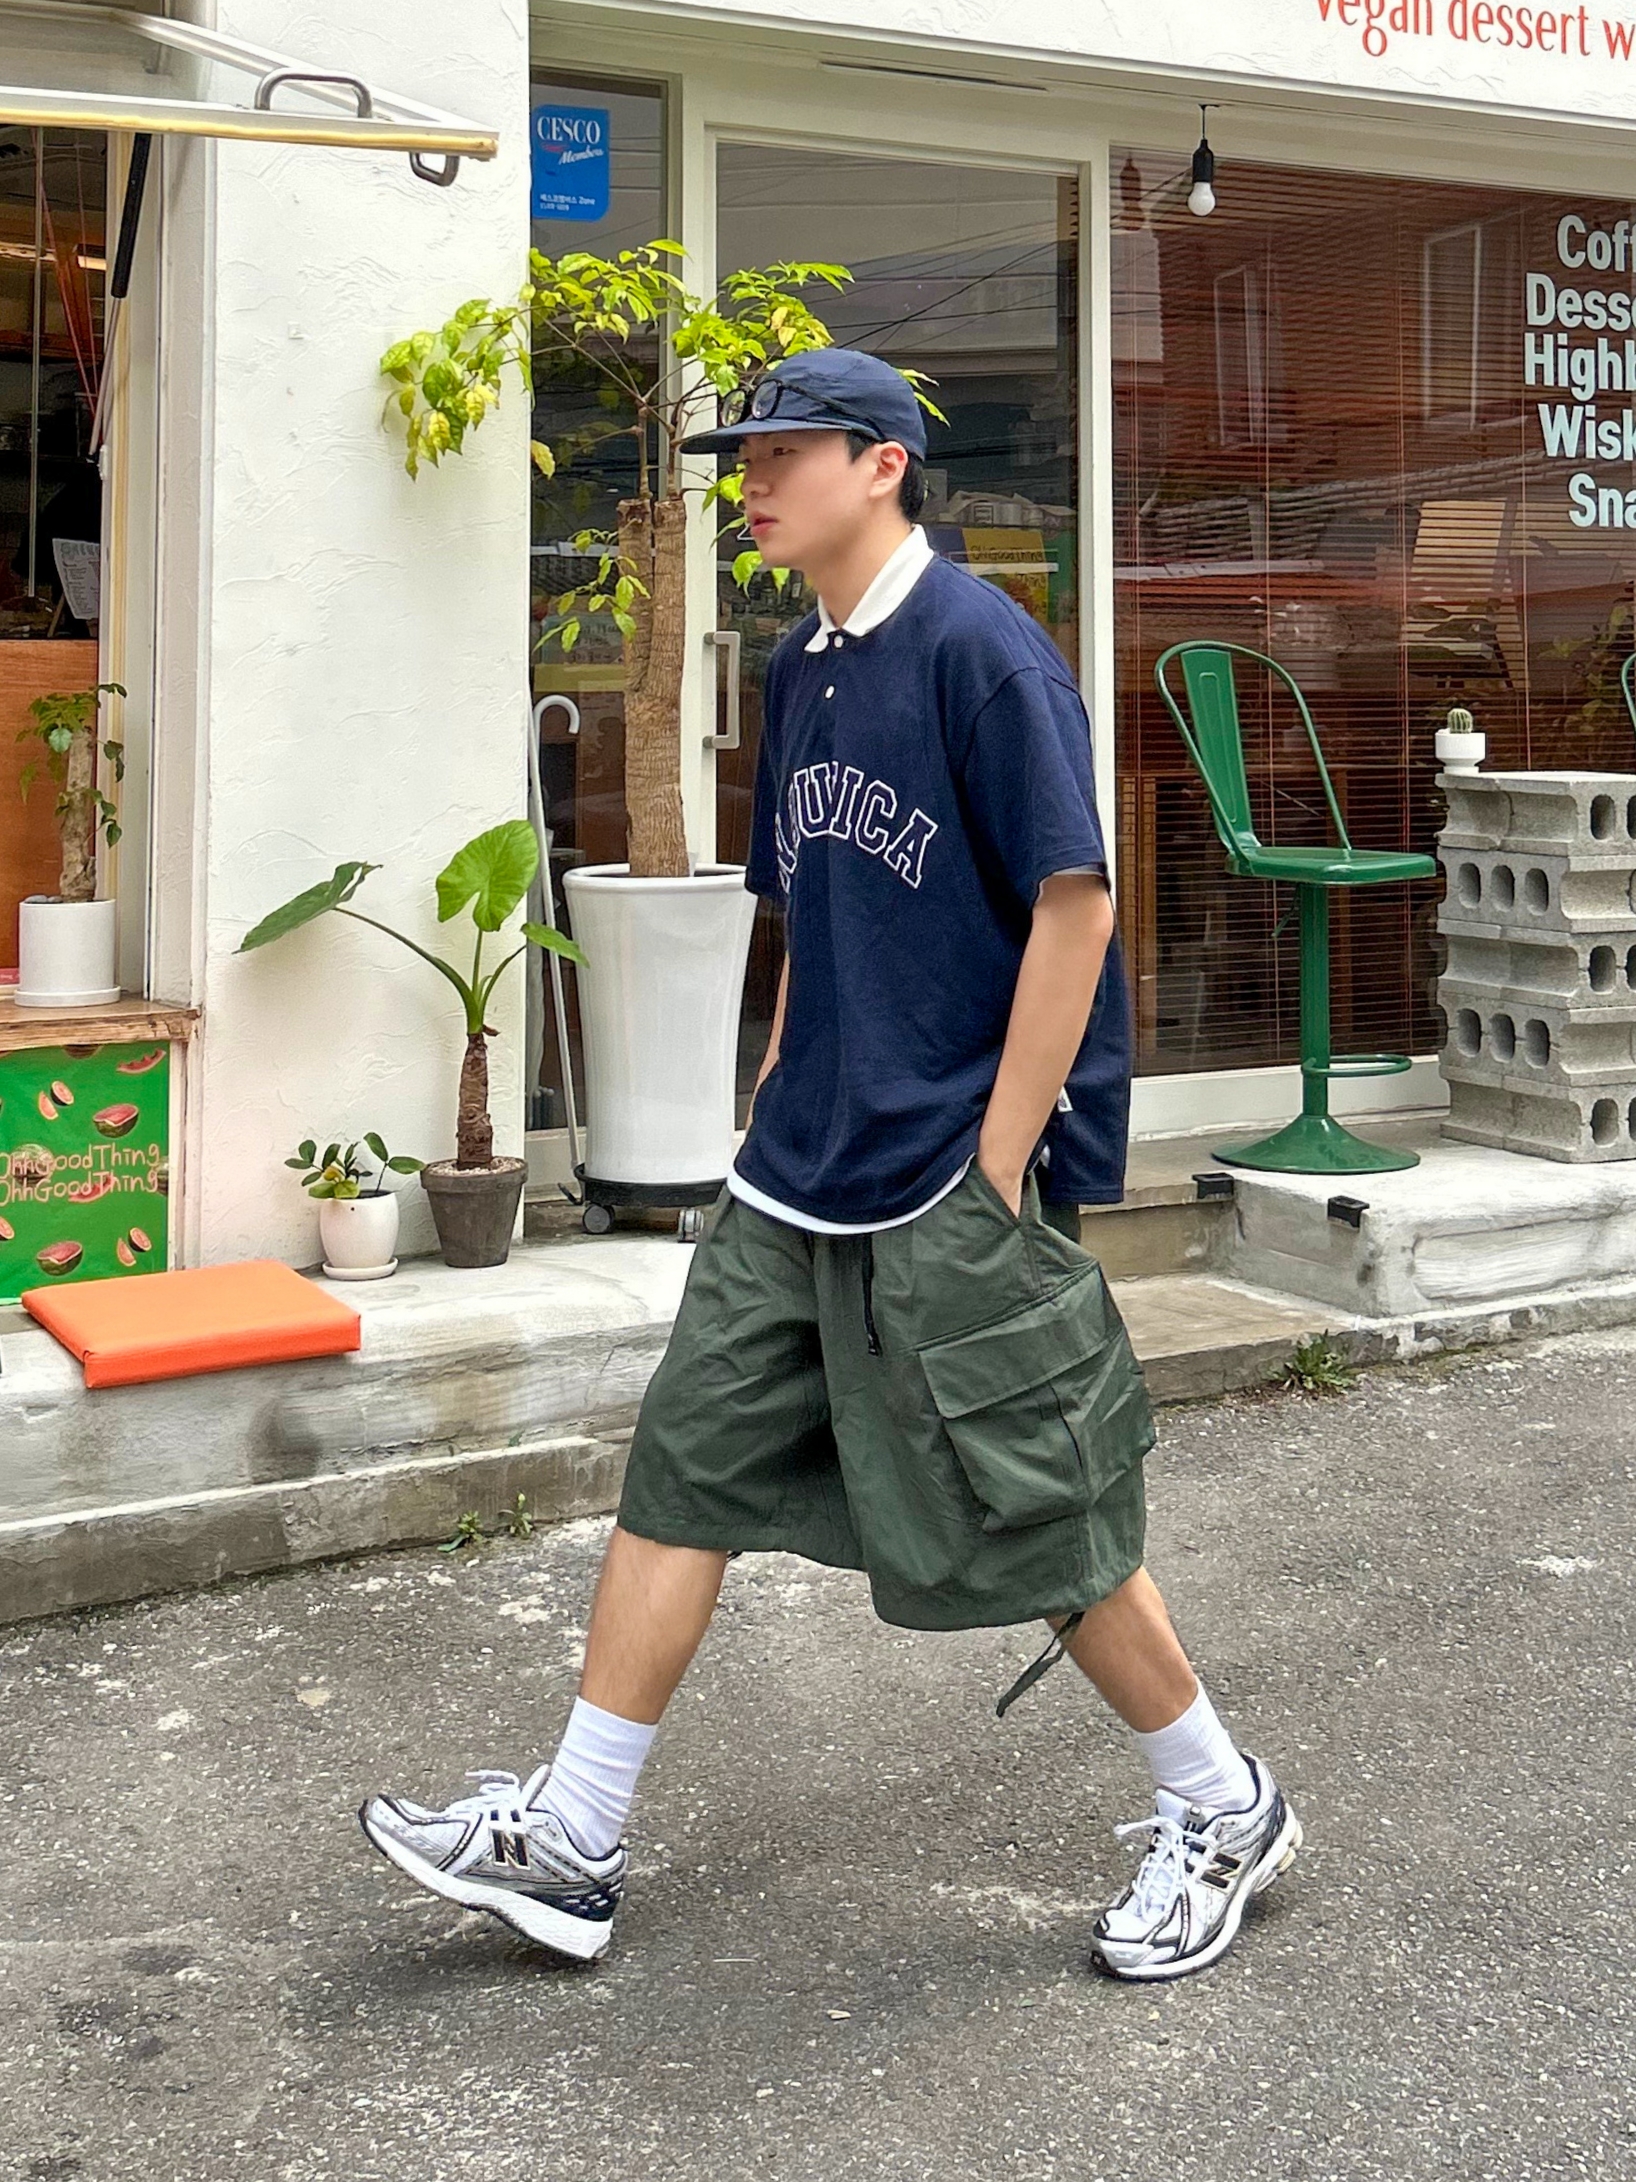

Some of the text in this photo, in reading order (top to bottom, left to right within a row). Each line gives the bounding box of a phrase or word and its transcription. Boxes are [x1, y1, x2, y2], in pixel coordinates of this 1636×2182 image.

[1317, 0, 1433, 57] vegan
[1447, 0, 1590, 57] dessert
[537, 116, 601, 144] CESCO
[1526, 272, 1636, 332] Dess
